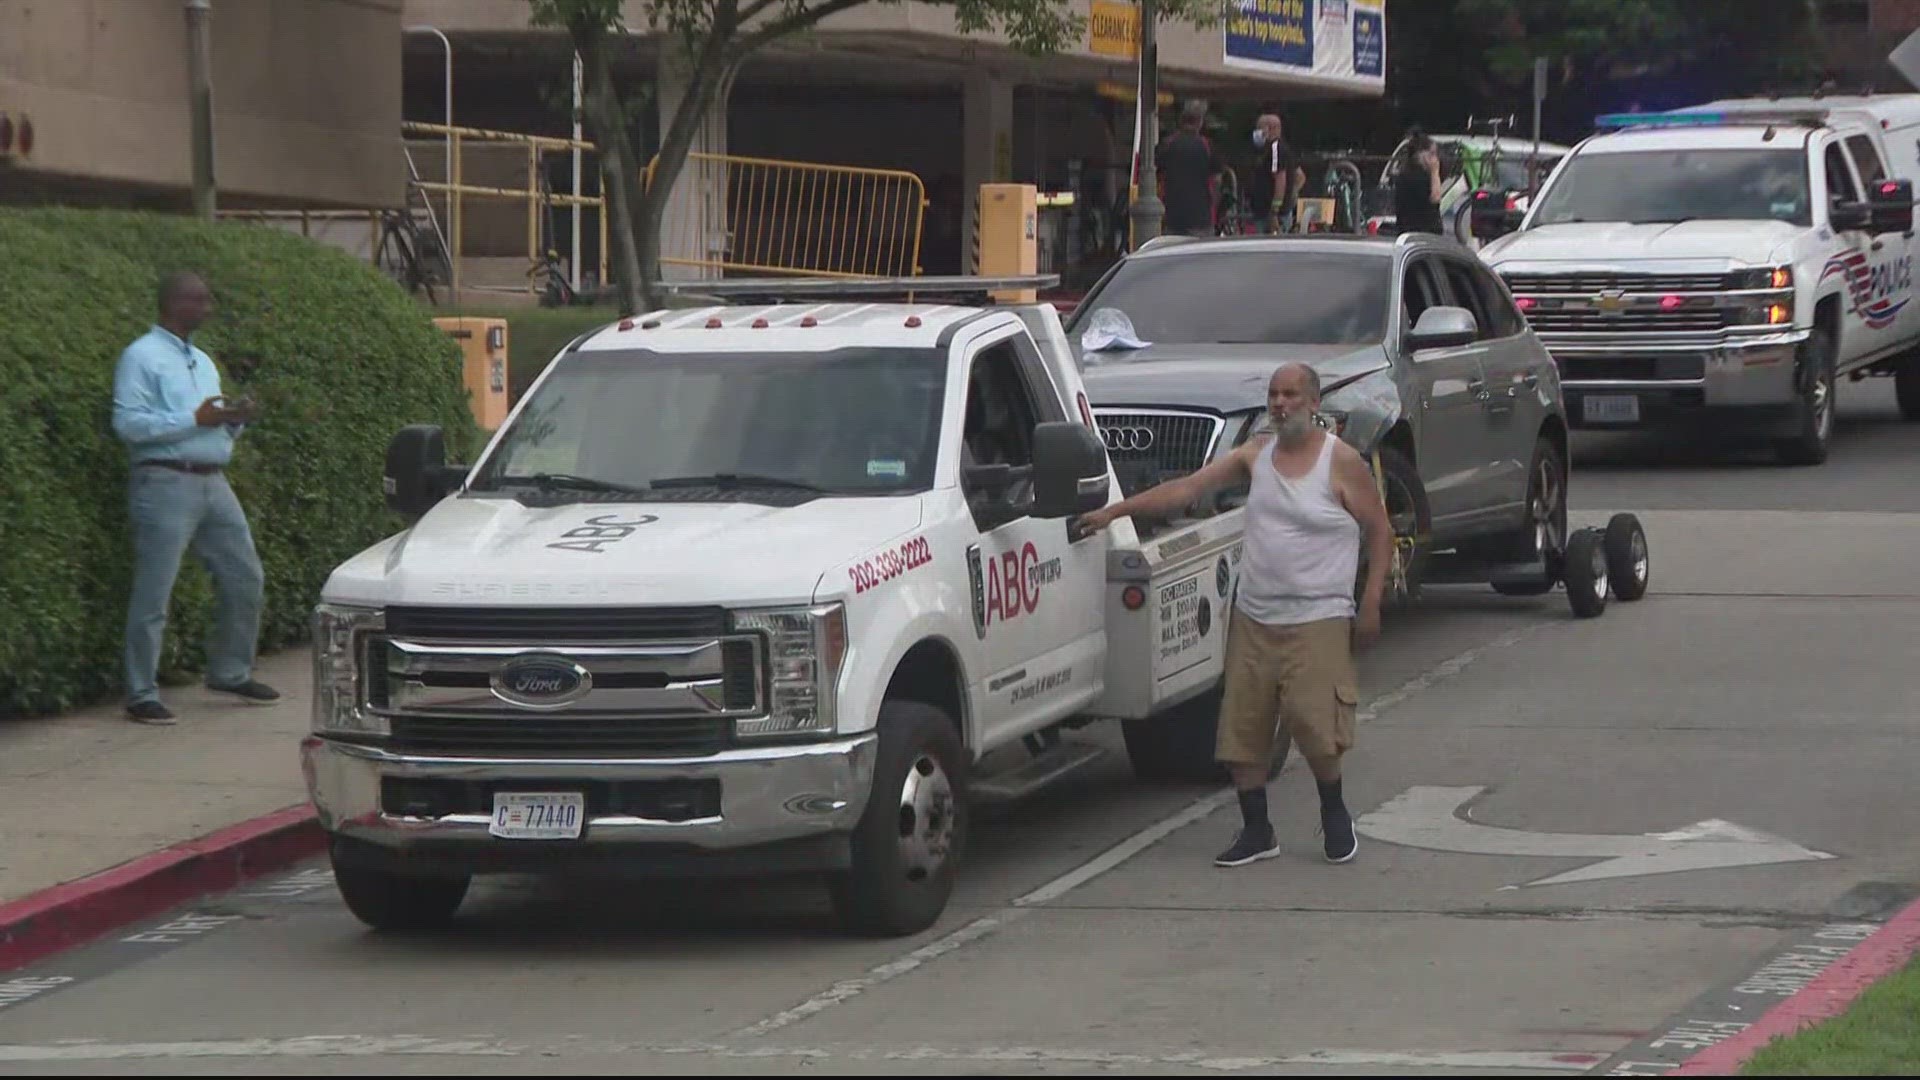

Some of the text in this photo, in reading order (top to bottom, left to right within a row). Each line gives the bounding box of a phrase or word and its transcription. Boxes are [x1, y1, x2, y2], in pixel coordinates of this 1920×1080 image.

[1092, 13, 1131, 42] CLEARANCE
[1871, 255, 1912, 297] POLICE
[546, 514, 660, 553] ABC
[848, 536, 933, 594] 202-338-2222
[1028, 556, 1062, 590] TOWING
[986, 541, 1040, 627] ABC
[1161, 578, 1197, 604] DC RATES
[515, 675, 562, 692] Ford
[525, 804, 576, 828] 77440
